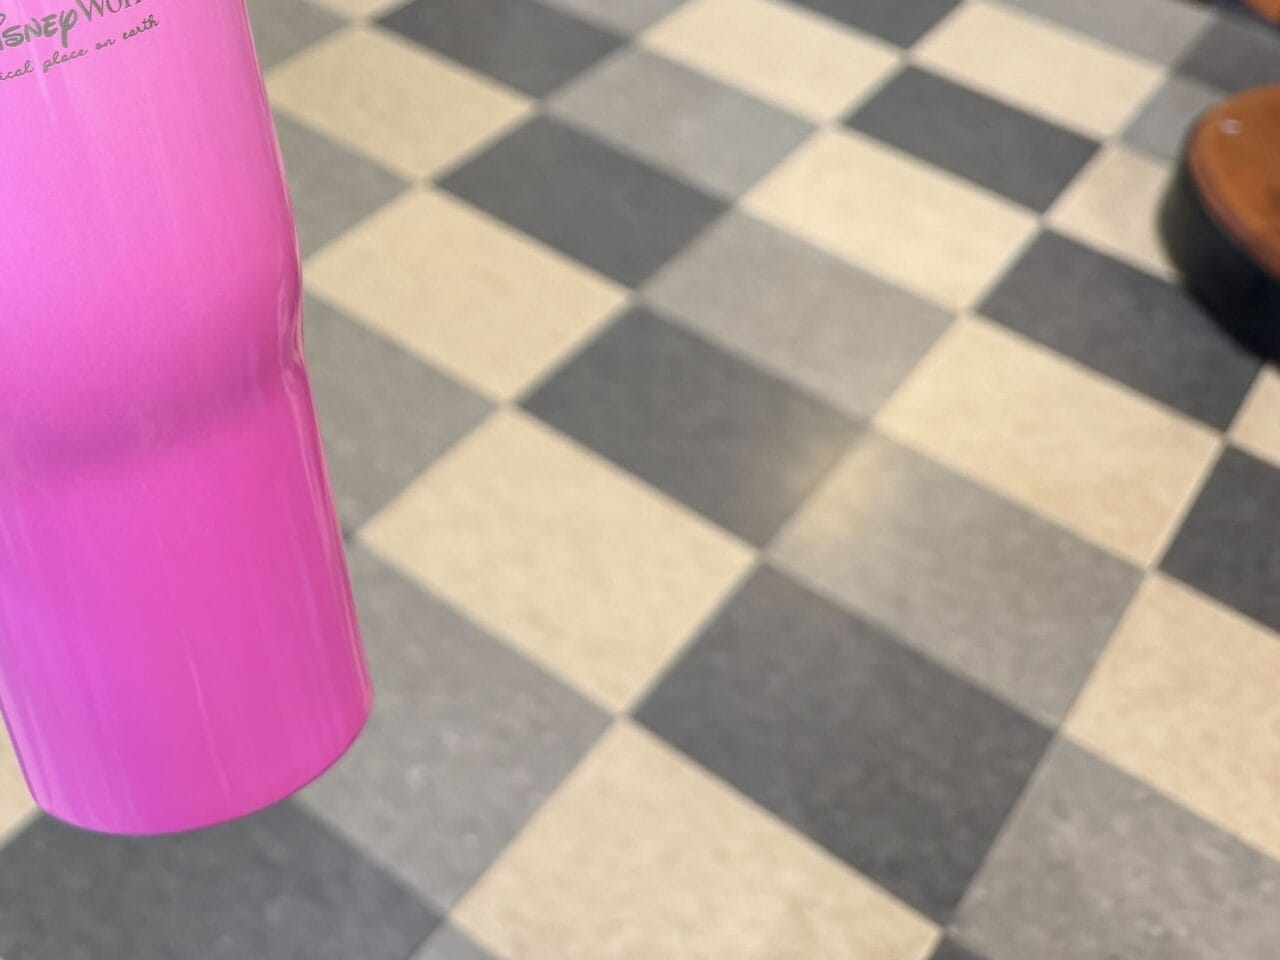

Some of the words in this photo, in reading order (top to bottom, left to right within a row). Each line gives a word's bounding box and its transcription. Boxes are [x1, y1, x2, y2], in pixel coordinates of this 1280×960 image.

[42, 50, 89, 73] place
[95, 38, 117, 50] on
[122, 14, 160, 40] earth
